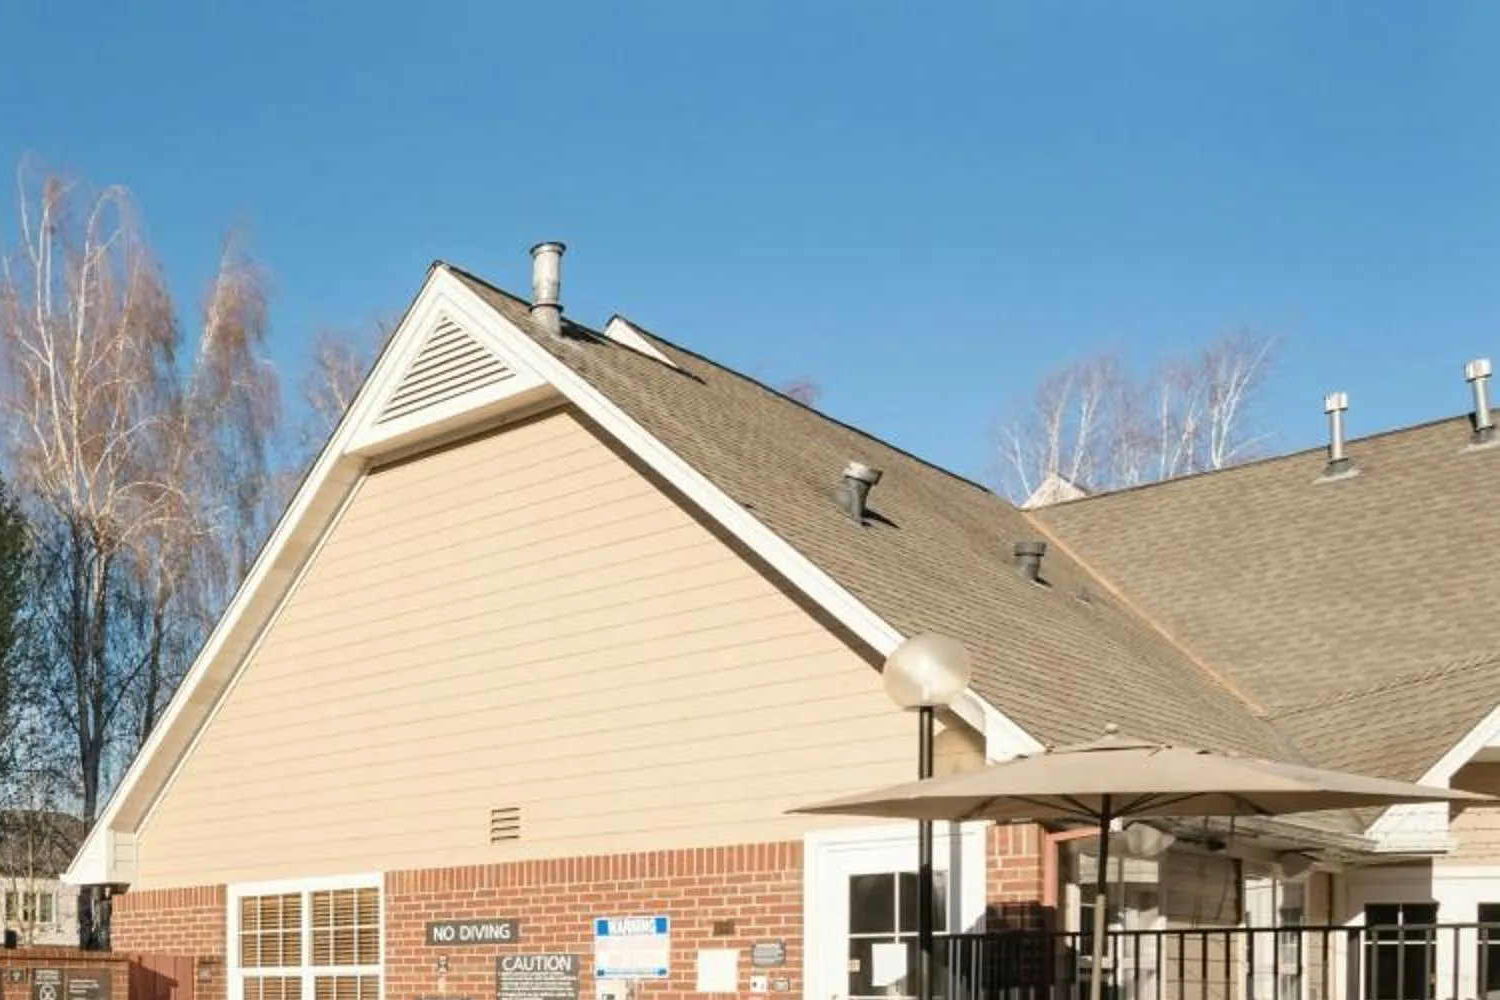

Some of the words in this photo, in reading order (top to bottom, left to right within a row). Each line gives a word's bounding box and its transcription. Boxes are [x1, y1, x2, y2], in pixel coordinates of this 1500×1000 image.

[433, 925, 455, 941] NO
[460, 923, 511, 940] DIVING
[502, 955, 571, 971] CAUTION
